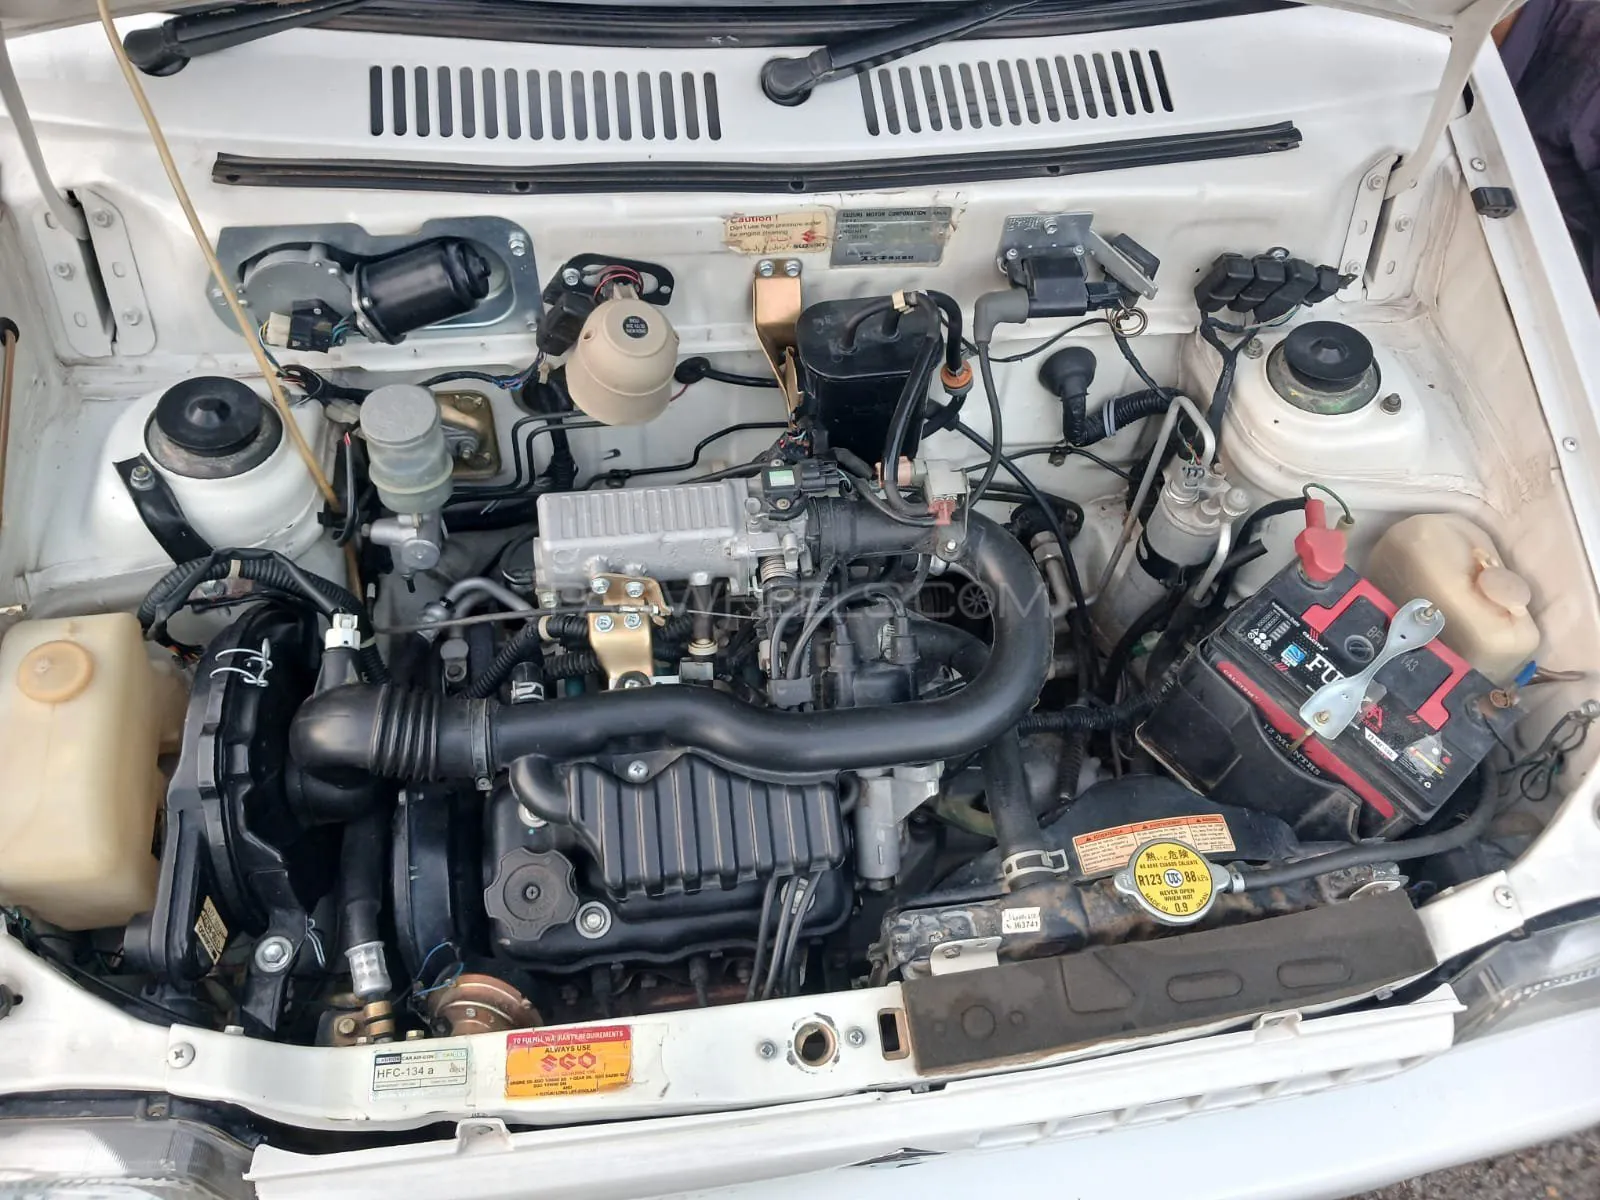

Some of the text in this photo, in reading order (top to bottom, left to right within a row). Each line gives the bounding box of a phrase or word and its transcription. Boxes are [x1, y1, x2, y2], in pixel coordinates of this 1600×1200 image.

[730, 213, 773, 223] Caution
[760, 222, 775, 231] high
[1138, 873, 1163, 887] R123
[1184, 870, 1197, 883] 88
[1179, 887, 1196, 895] OPEN
[1174, 901, 1189, 913] 0.9
[512, 1037, 521, 1045] TO
[545, 1043, 592, 1054] ALWAYS USE
[377, 1065, 434, 1079] HFC-134 a
